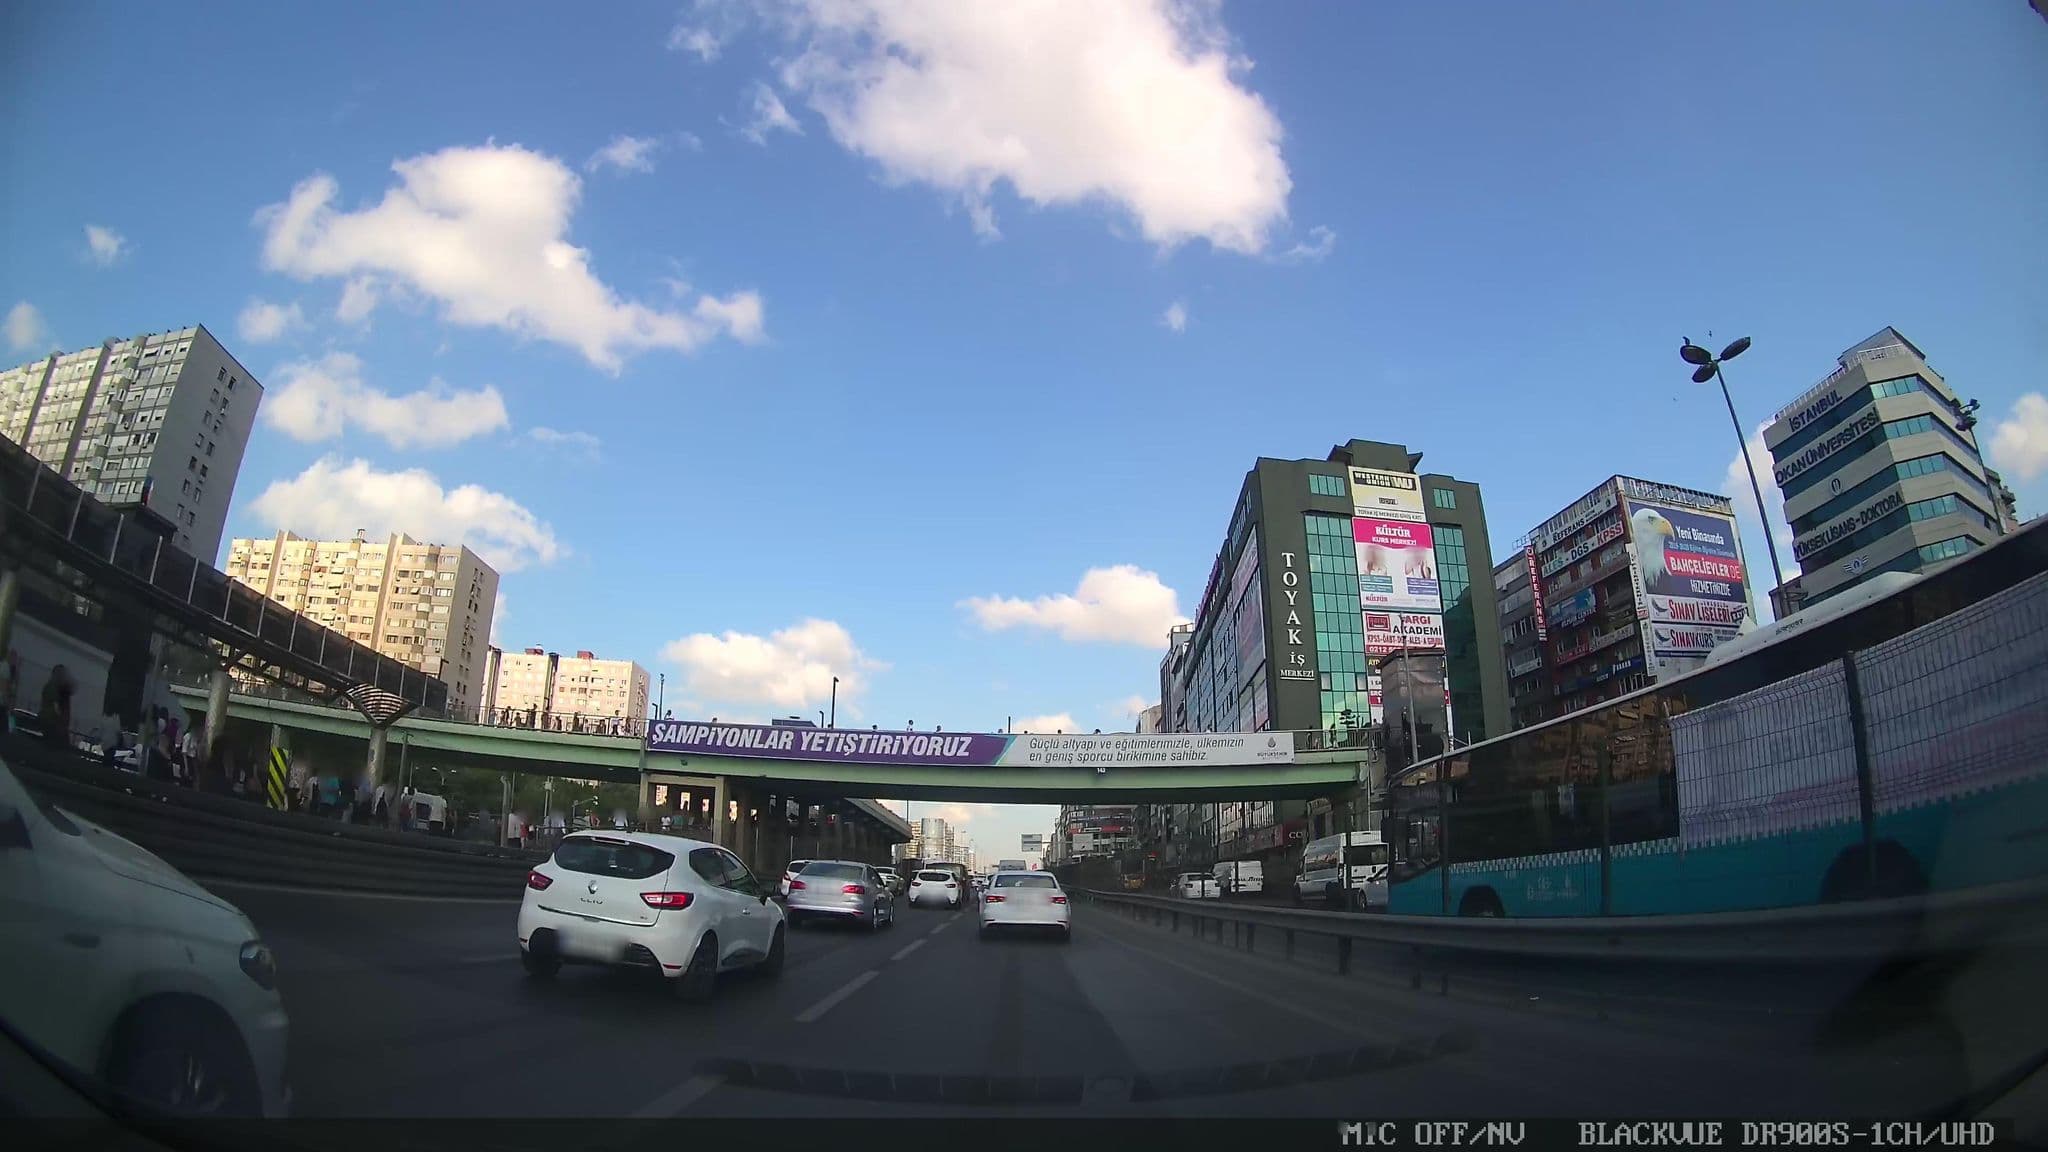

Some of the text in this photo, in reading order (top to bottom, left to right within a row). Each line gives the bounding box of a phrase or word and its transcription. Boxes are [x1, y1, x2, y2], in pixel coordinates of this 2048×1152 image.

[1788, 390, 1843, 433] İSTANBUL
[1774, 406, 1880, 485] OKAN ÜNİVERSİTESİ
[1375, 524, 1411, 538] KÜLTÜR
[1553, 518, 1585, 542] REFERANS
[1675, 525, 1692, 540] Yeni
[1570, 542, 1590, 561] DGS
[1281, 552, 1303, 645] TOYAK
[1668, 598, 1696, 620] SINAV
[1280, 669, 1314, 678] MERKEZİ
[651, 722, 973, 757] ŞAMPİYONLAR YETİŞTİRİYORUZ
[1062, 738, 1097, 752] altyapı
[1100, 740, 1112, 749] ve
[1029, 752, 1042, 761] en
[1077, 752, 1114, 764] sporcu
[1116, 750, 1167, 761] birikimine
